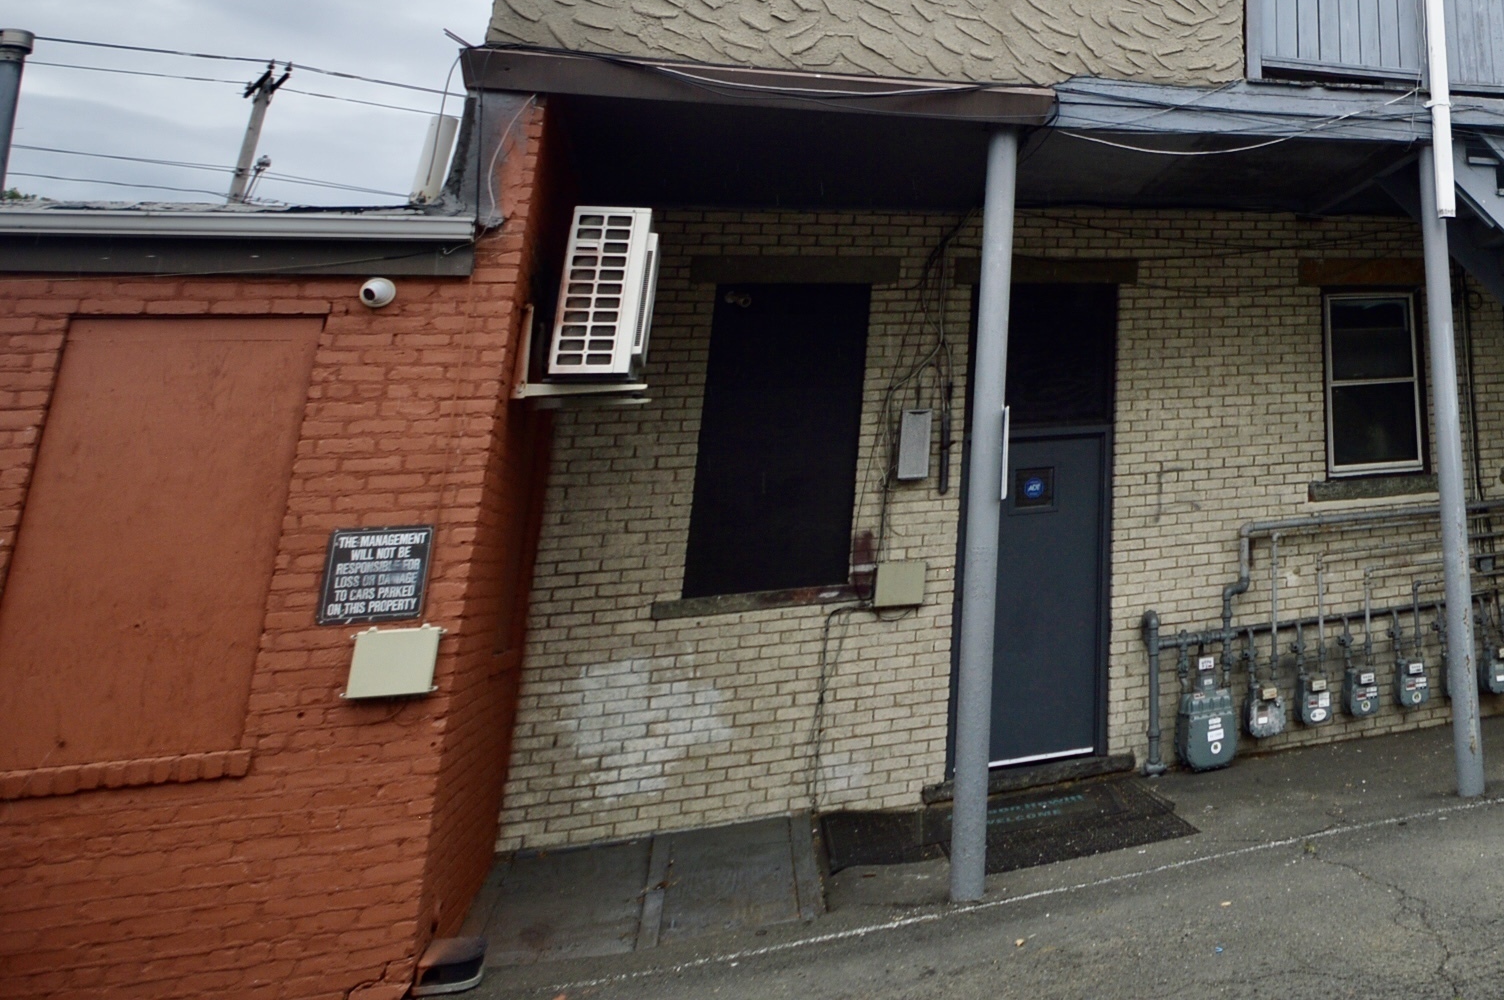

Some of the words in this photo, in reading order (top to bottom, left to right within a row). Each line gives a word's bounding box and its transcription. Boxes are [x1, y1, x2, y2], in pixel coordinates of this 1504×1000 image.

[338, 536, 358, 549] THE
[360, 532, 428, 547] MANAGEMENT
[351, 548, 374, 561] WILL
[376, 547, 397, 560] NOT
[398, 546, 412, 559] BE
[402, 558, 421, 571] FOR
[334, 575, 360, 589] LOSS
[361, 574, 377, 587] OR
[334, 590, 348, 602] TO
[349, 588, 376, 601] CARS
[378, 585, 416, 599] PARKED
[327, 603, 341, 616] ON
[343, 601, 366, 614] THIS
[367, 598, 418, 613] PROPERTY
